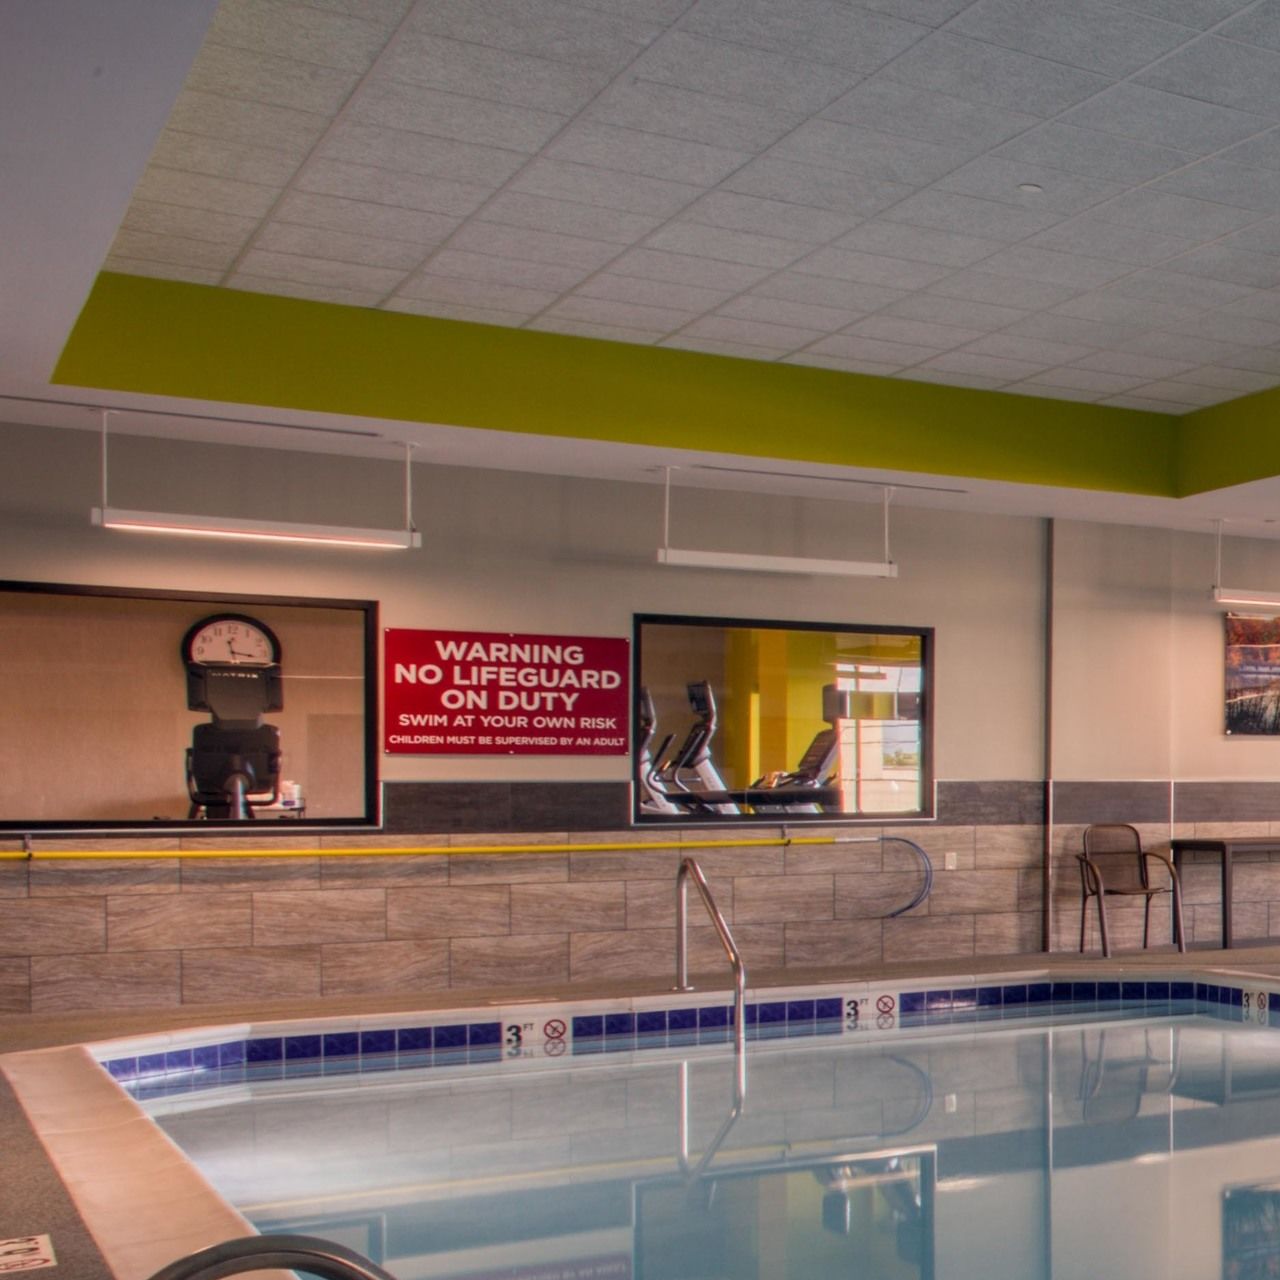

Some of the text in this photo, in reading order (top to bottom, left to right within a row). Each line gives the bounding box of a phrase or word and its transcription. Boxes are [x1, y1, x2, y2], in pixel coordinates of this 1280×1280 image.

[434, 640, 585, 665] WARNING
[394, 663, 622, 689] NO LIFEGUARD
[440, 689, 580, 711] ON DUTY
[398, 713, 617, 729] SWIM AT YOUR OWN RISK
[389, 734, 625, 747] CHILDREN MUST BE SUPERVISED BY AN ADULT
[846, 1000, 859, 1019] 3
[506, 1023, 535, 1045] 3 FT
